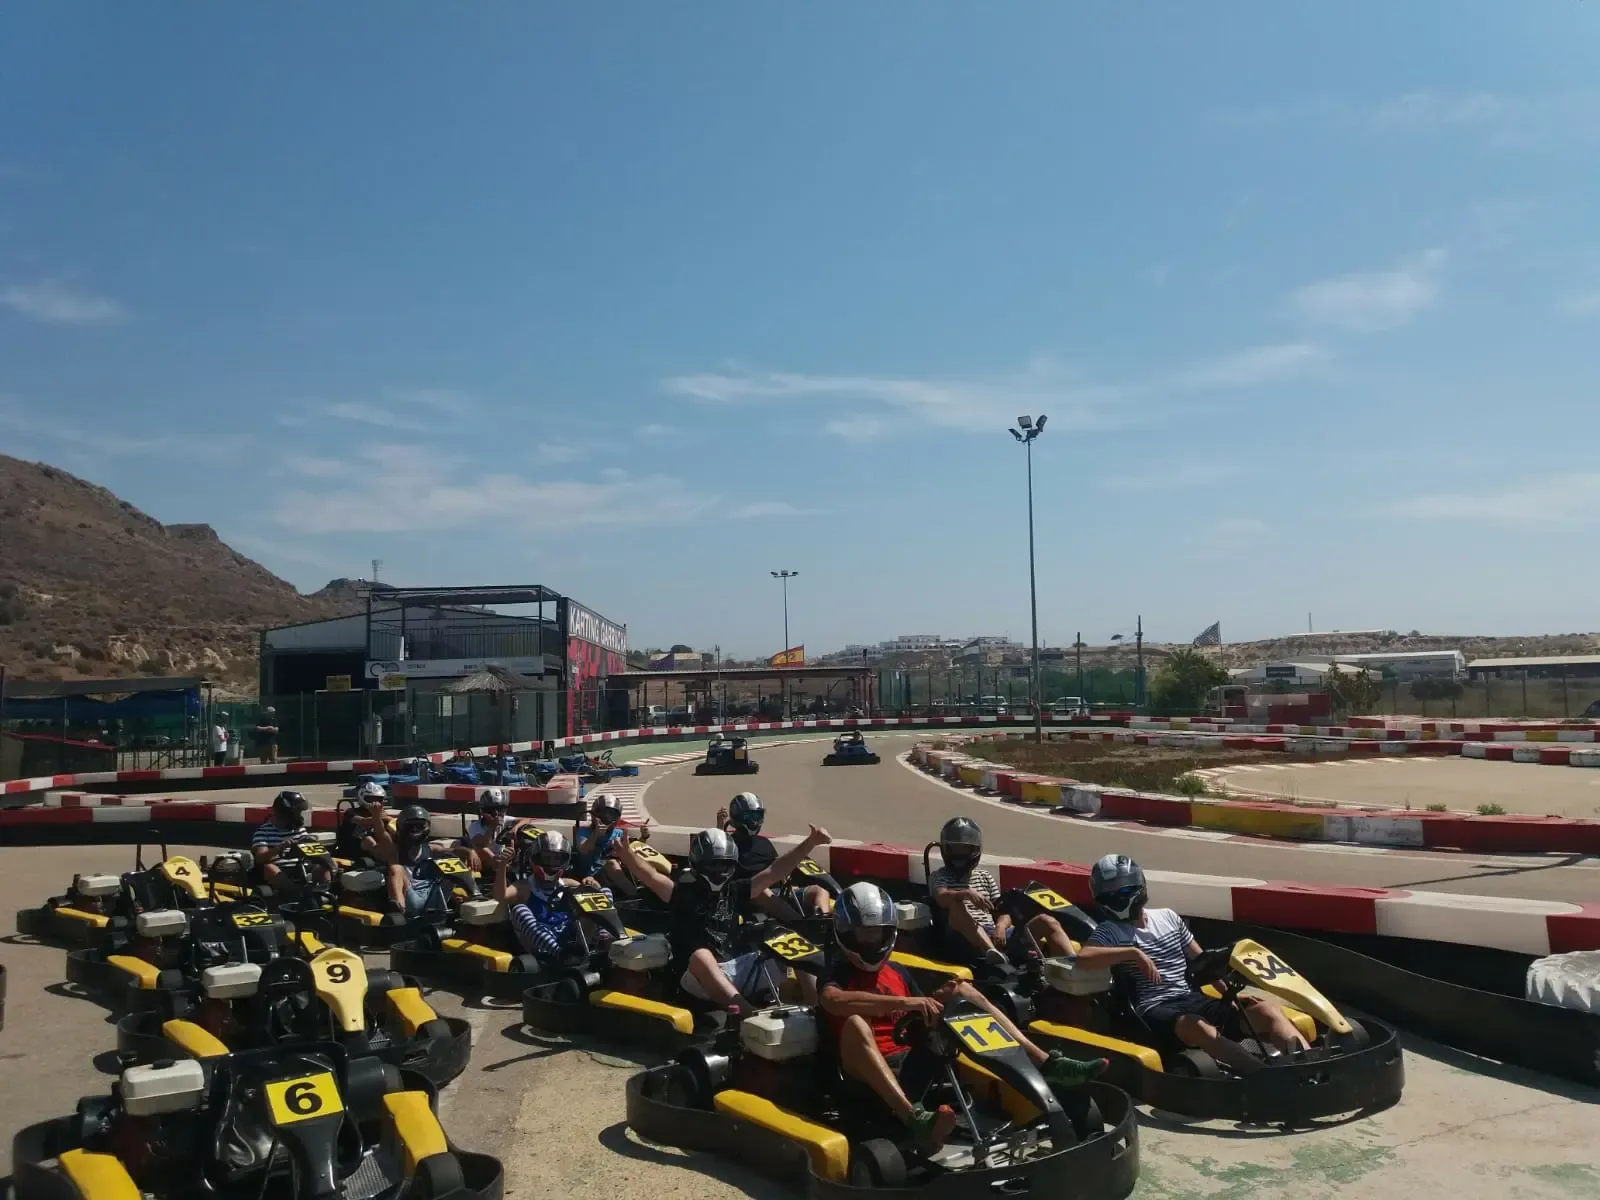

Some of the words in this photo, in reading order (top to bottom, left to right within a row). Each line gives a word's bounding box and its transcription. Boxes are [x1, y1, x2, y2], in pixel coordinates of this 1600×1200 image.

[570, 606, 600, 643] KARTING
[301, 844, 326, 854] 35
[635, 848, 659, 858] 13
[175, 866, 191, 876] 4
[438, 861, 467, 873] 31
[800, 862, 822, 873] 10
[580, 896, 609, 911] 15
[1039, 893, 1065, 907] 2
[236, 915, 273, 926] 32
[771, 937, 815, 957] 33
[326, 963, 352, 984] 9
[1242, 955, 1297, 981] 34
[959, 1020, 1016, 1048] 11
[284, 1081, 323, 1116] 6
